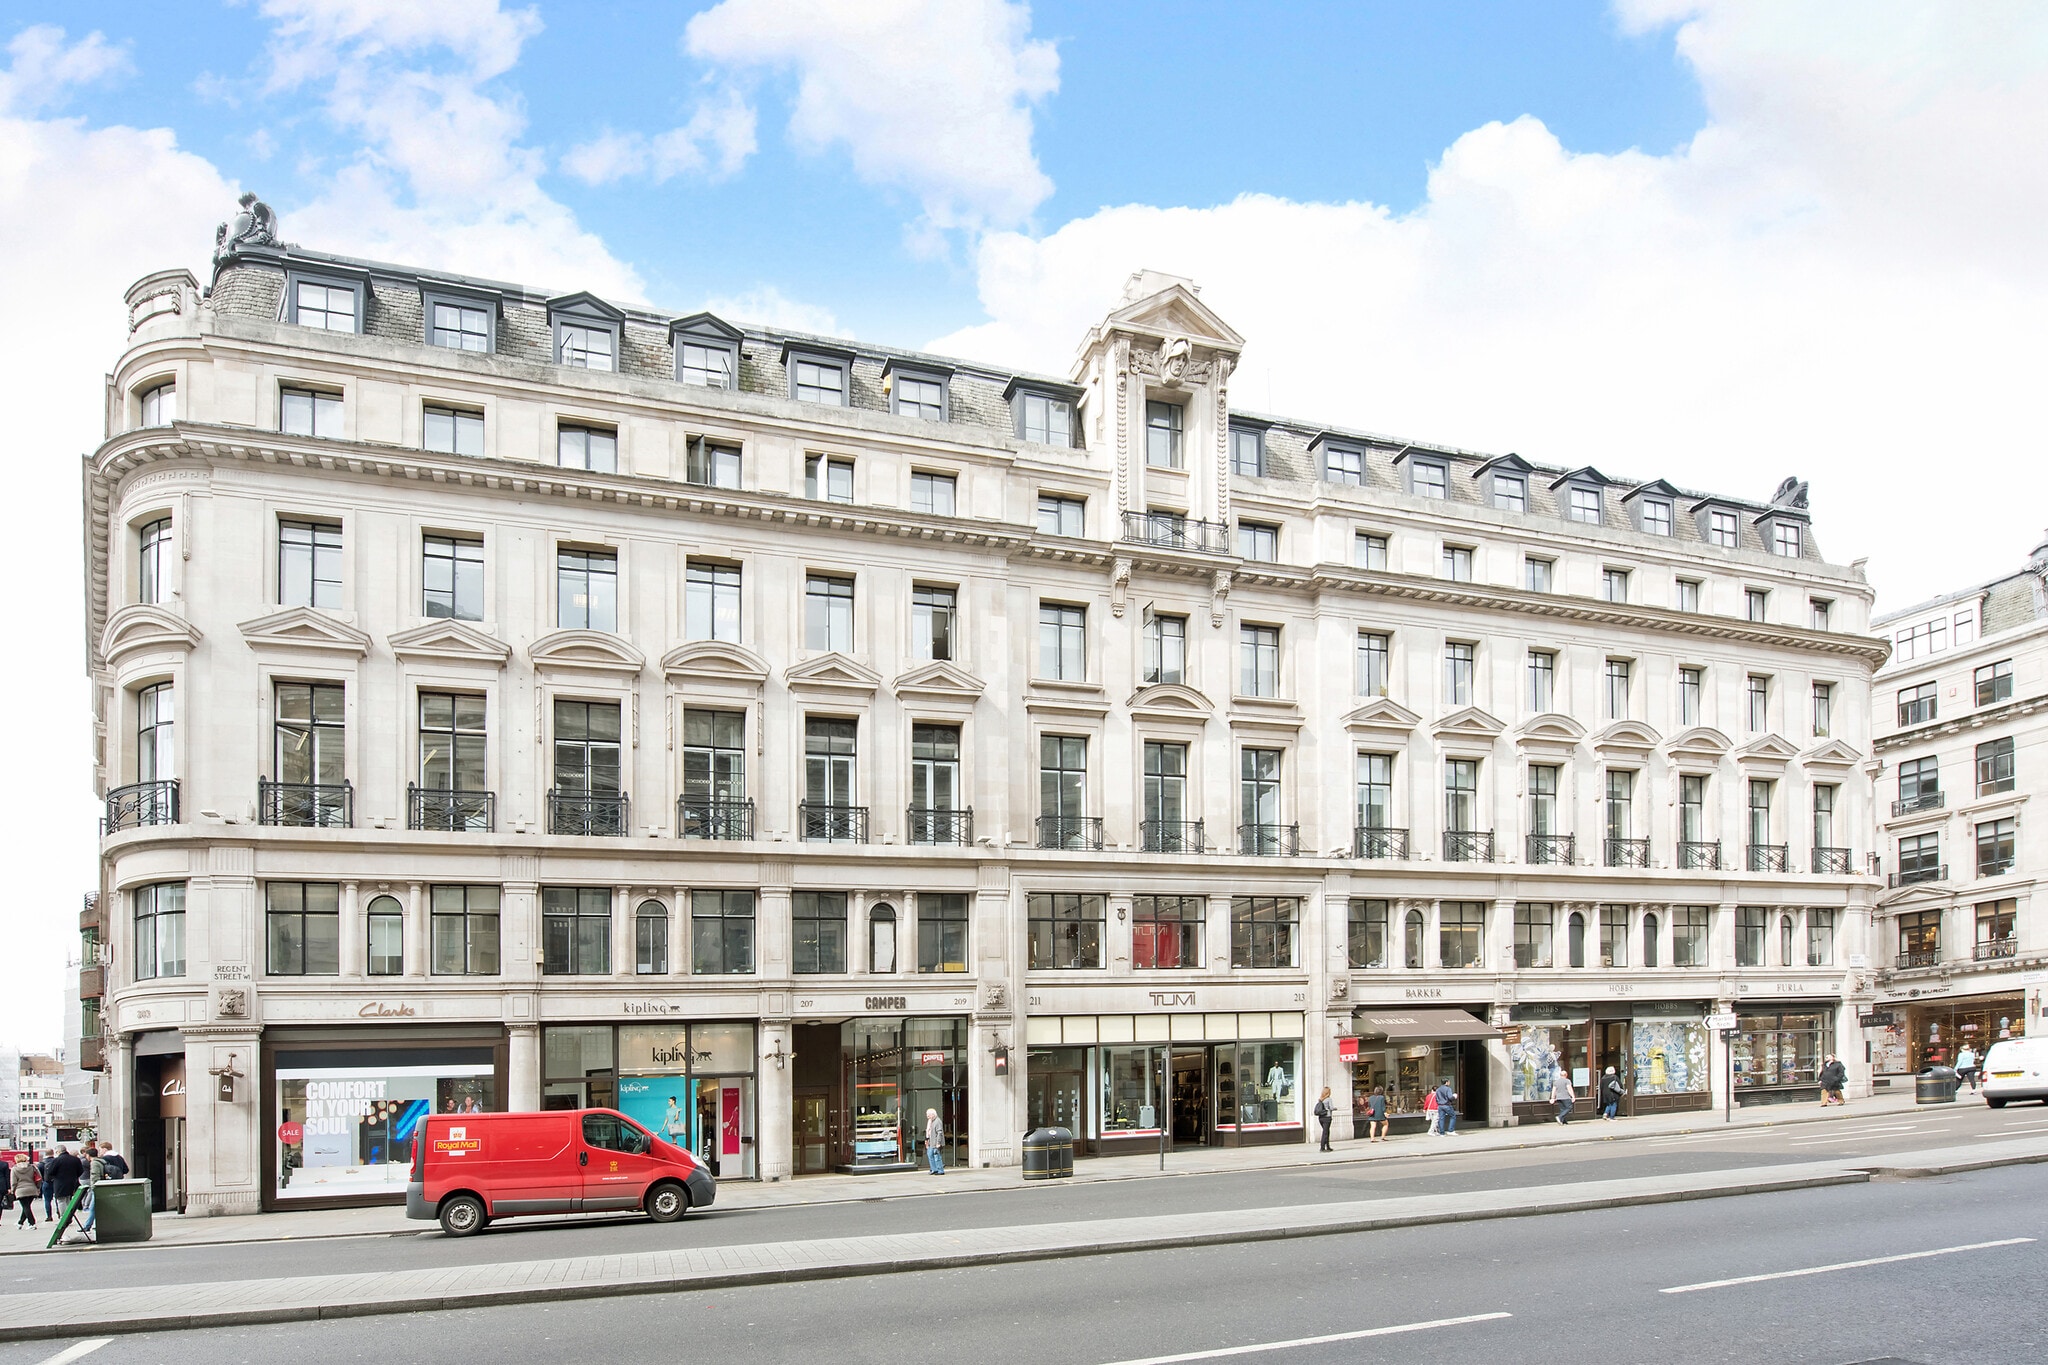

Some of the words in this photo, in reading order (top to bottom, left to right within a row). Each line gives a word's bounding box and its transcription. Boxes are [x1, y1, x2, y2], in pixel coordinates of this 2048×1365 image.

[216, 965, 247, 973] REGENT
[214, 973, 241, 981] STREET
[1776, 983, 1804, 992] FURLA
[1294, 993, 1305, 1001] 213
[1405, 988, 1442, 998] BARKER
[865, 996, 907, 1010] CAMPER
[954, 998, 967, 1006] 209
[1029, 996, 1041, 1006] 211
[1149, 991, 1196, 1007] TUMI
[623, 1001, 666, 1015] kipling
[800, 1000, 814, 1008] 207
[1654, 1002, 1678, 1010] HOBBS
[358, 1001, 415, 1018] Clarks
[1533, 1005, 1559, 1013] HOBBS
[1862, 1016, 1890, 1024] FURLA
[162, 1079, 186, 1096] Cla
[306, 1081, 387, 1100] COMFORT
[306, 1100, 324, 1118] IN
[326, 1099, 372, 1117] YOUR
[306, 1117, 349, 1136] SOUL
[437, 1142, 460, 1150] Royal
